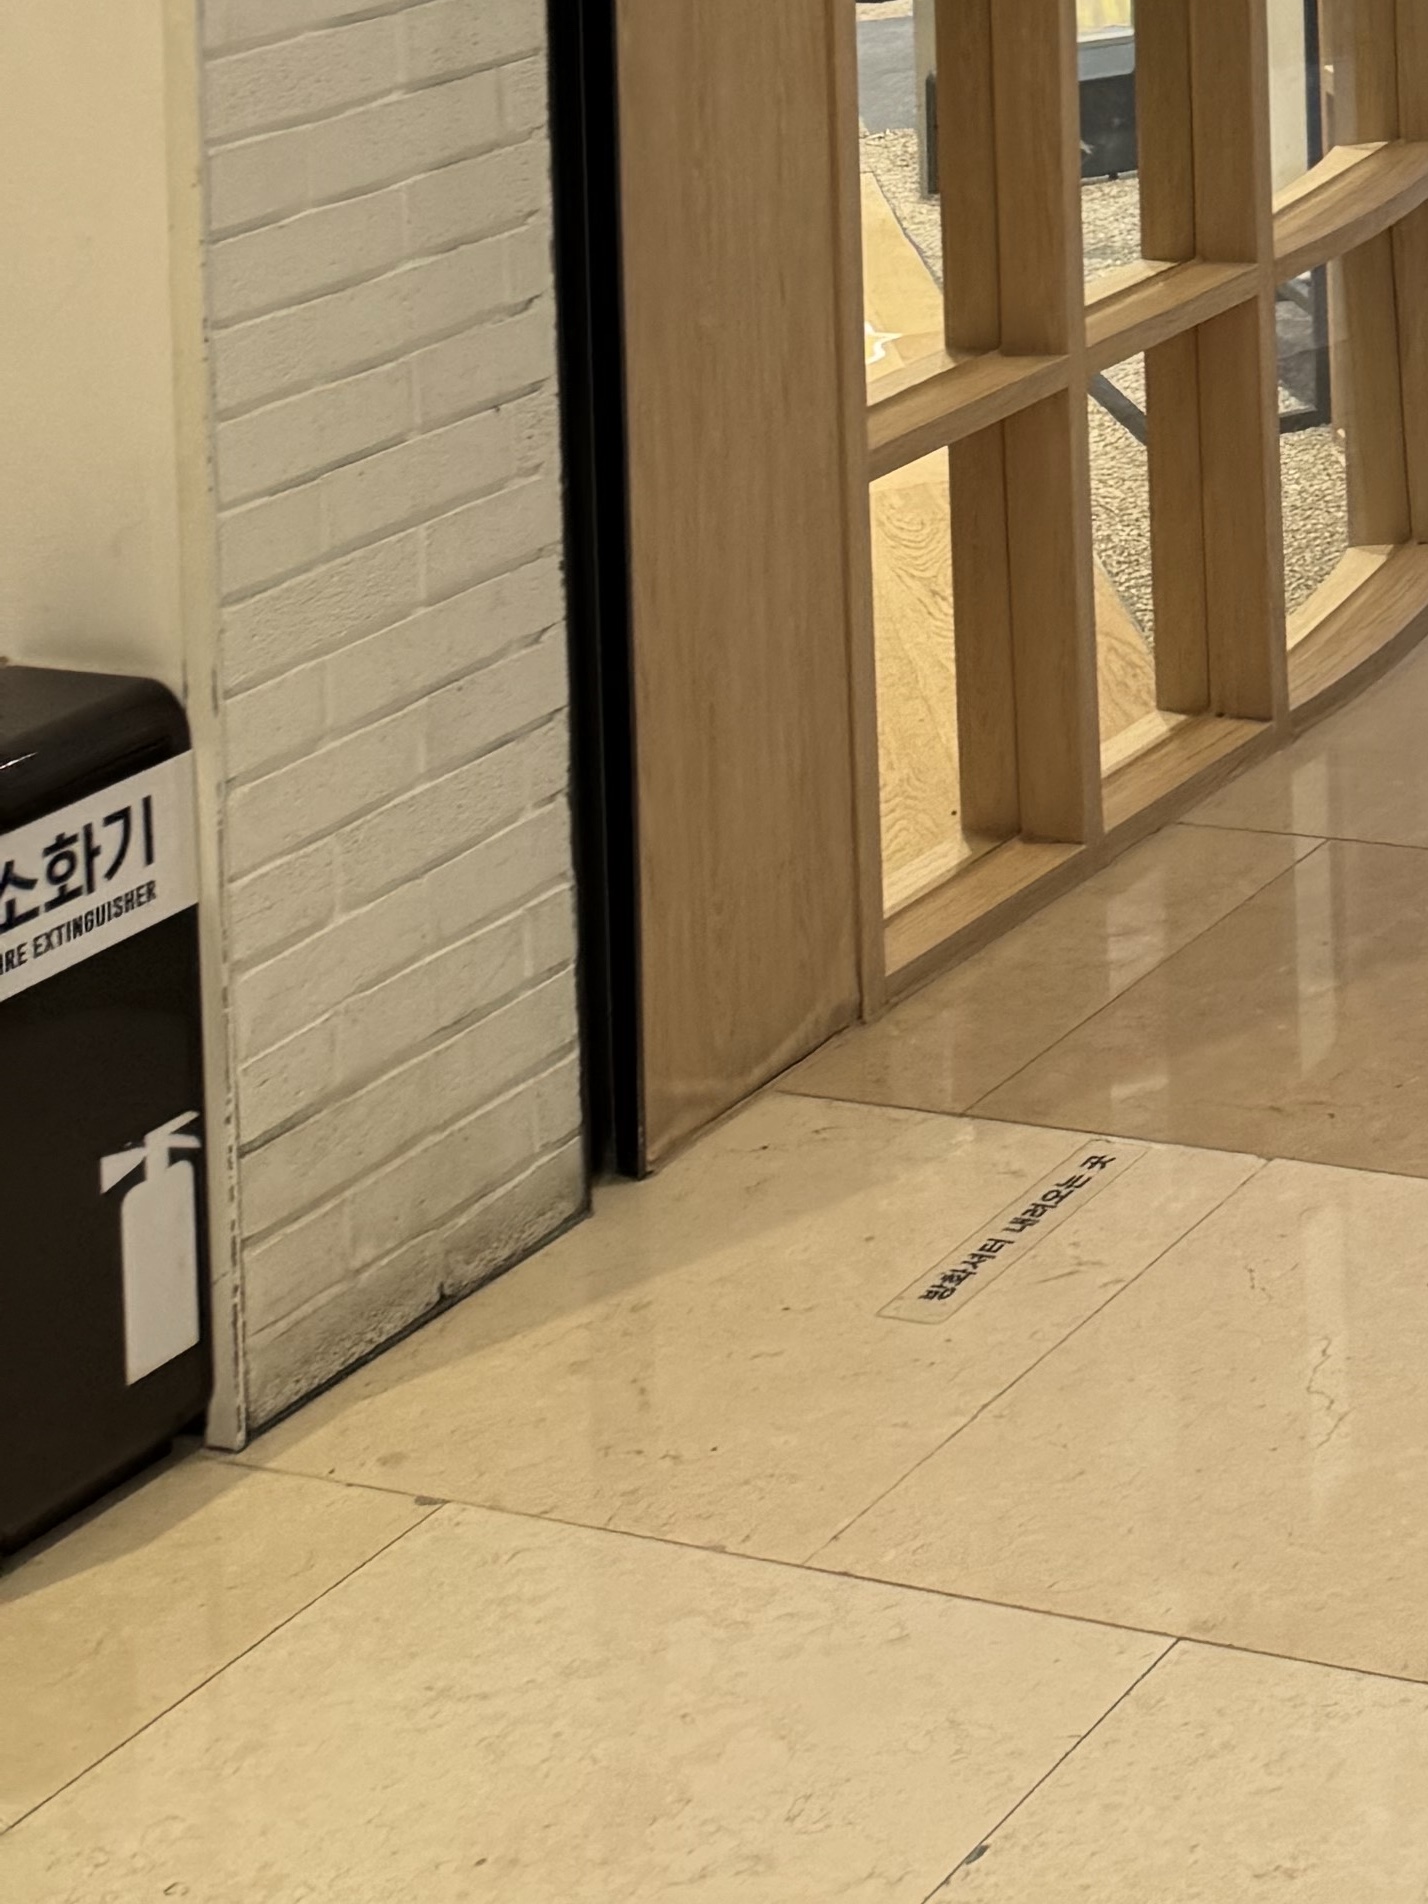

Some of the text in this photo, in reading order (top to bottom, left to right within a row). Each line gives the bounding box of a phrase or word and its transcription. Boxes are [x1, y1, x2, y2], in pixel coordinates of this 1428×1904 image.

[0, 794, 155, 935] 소화기
[32, 879, 157, 960] EXTINGUISHER
[917, 1154, 1117, 1301] 방화셔터 내려오는 곳
